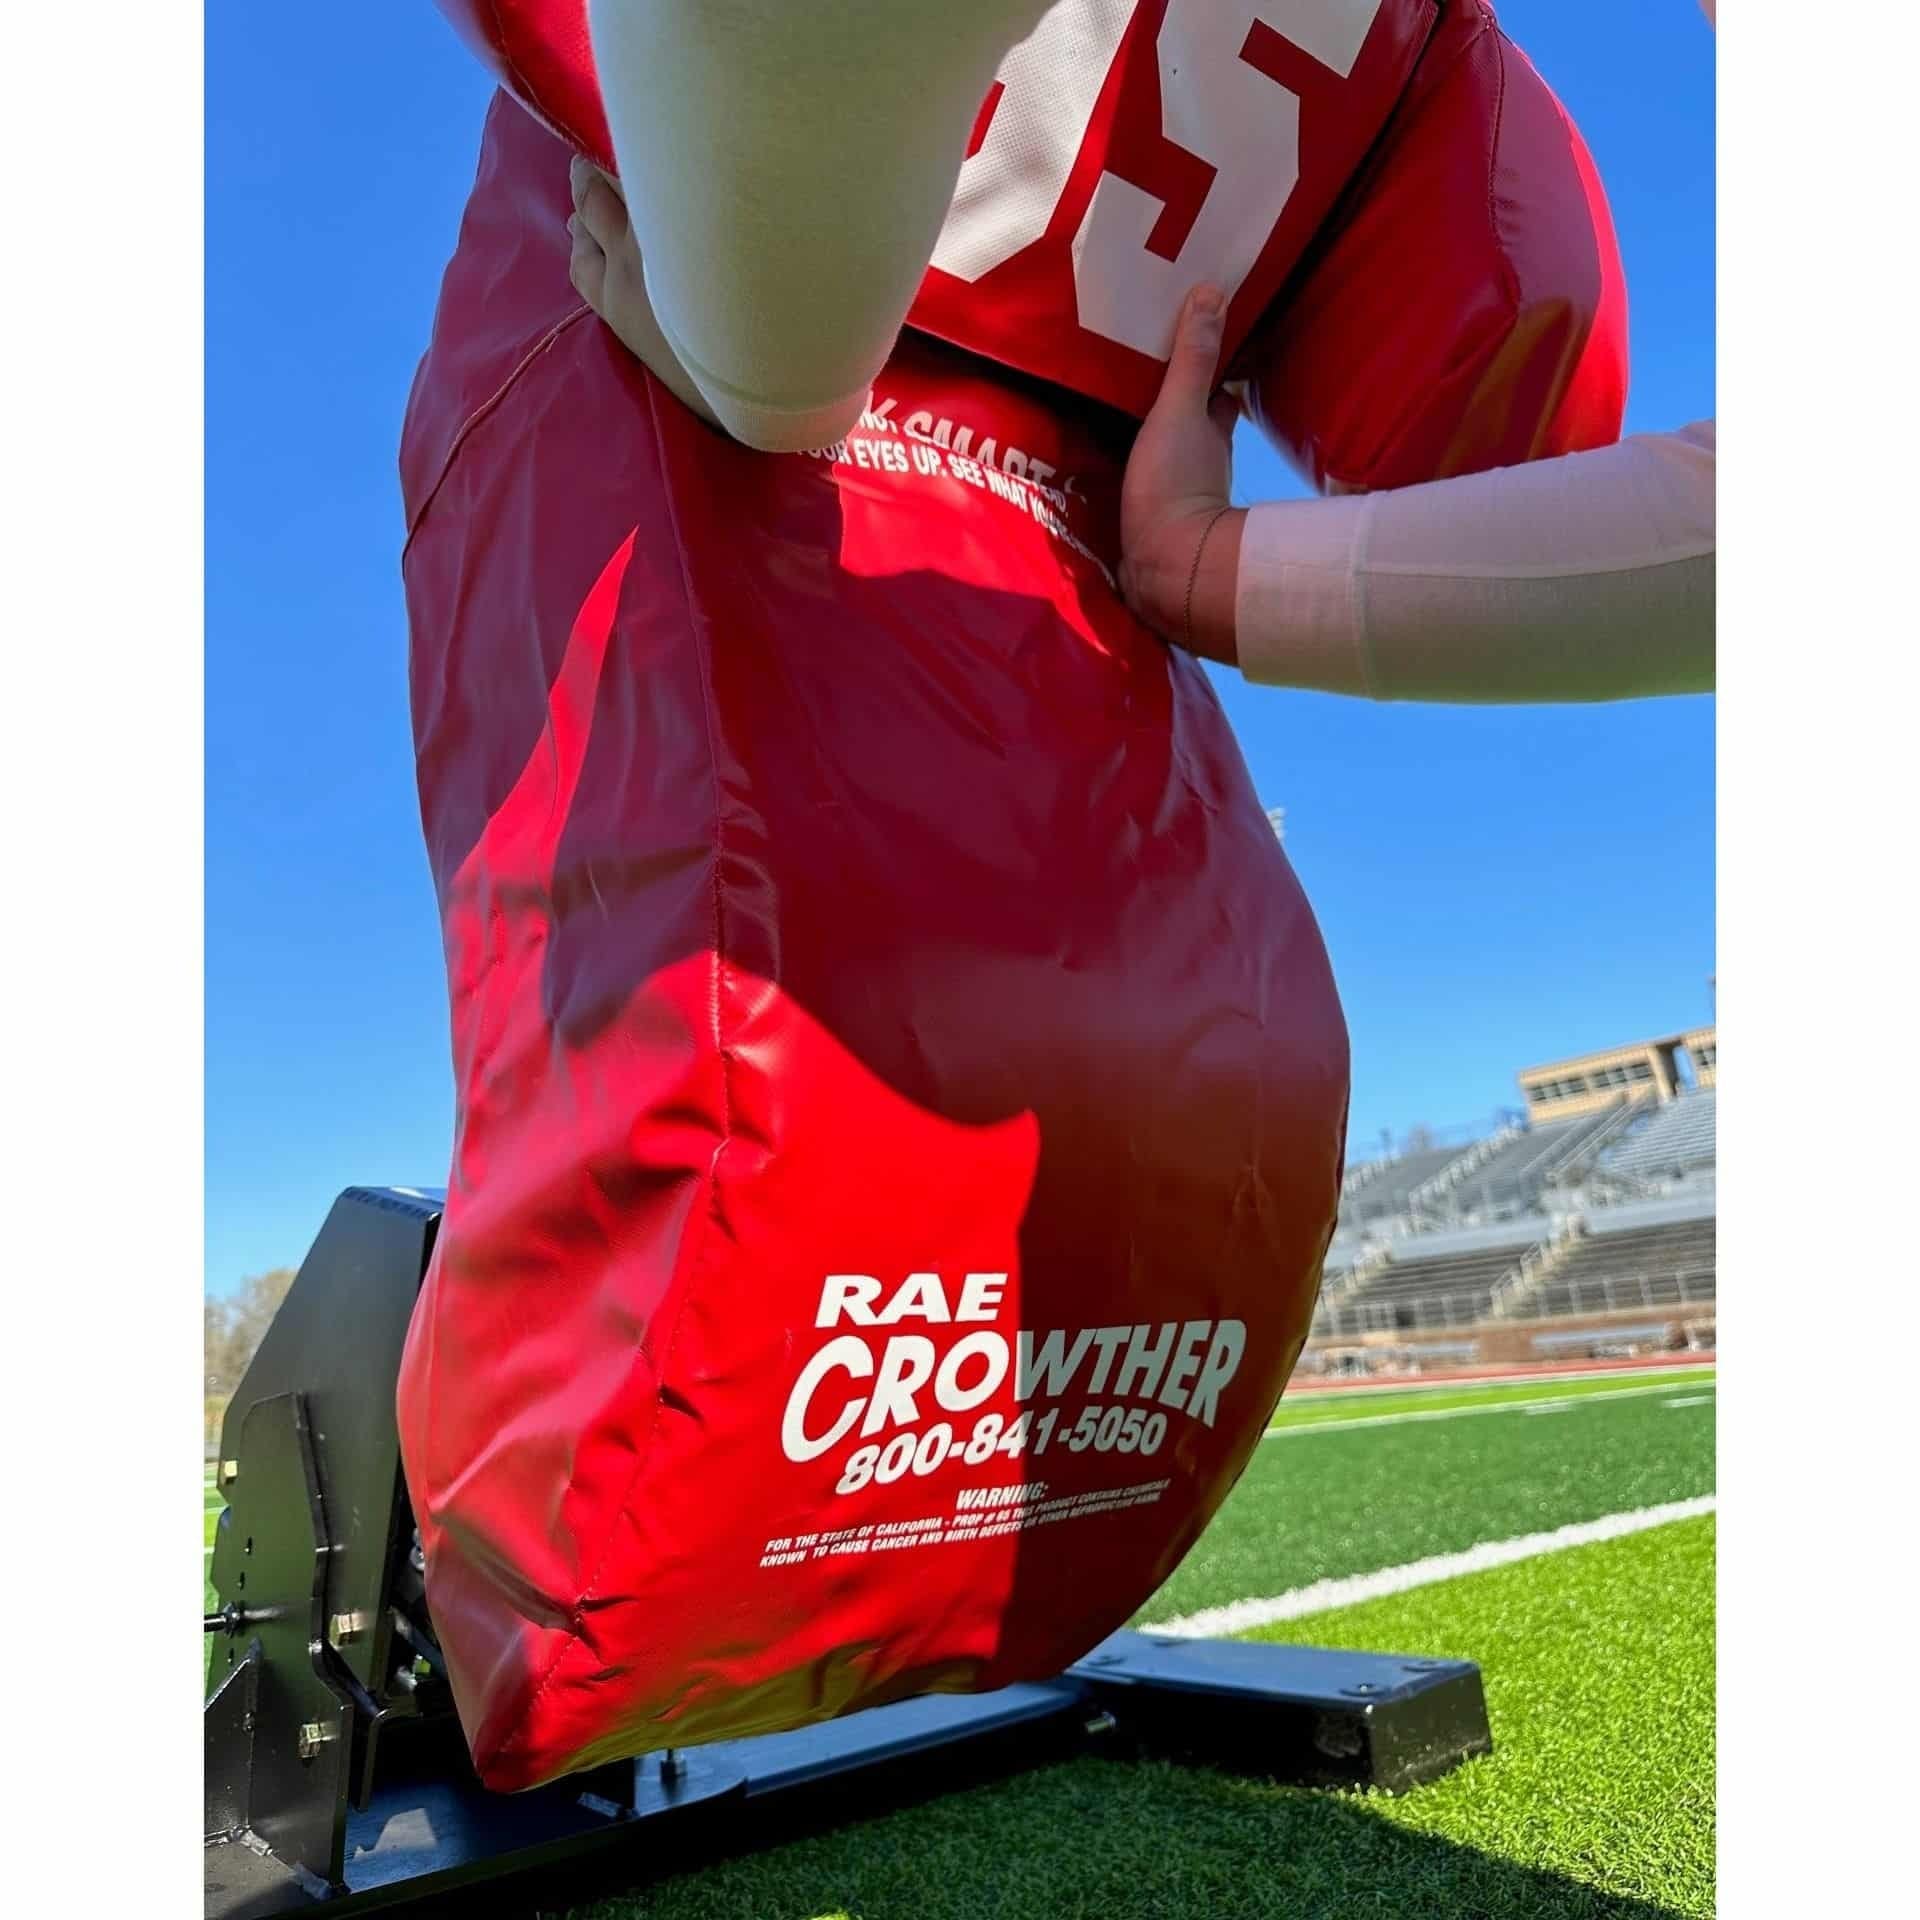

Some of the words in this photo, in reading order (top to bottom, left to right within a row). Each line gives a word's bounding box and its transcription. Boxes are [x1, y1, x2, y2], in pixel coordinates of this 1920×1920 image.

[852, 438, 909, 473] EYES
[911, 441, 948, 477] UP.
[947, 453, 985, 488] SEE
[982, 464, 1029, 513] WHAT
[814, 1272, 1009, 1329] RAE
[780, 1319, 1248, 1463] CROWTHER
[834, 1405, 1169, 1495] 800-841-5050
[956, 1481, 1049, 1510] WARNING:
[760, 1550, 807, 1568] KNOWN
[812, 1545, 828, 1559] TO
[829, 1539, 870, 1554] CAUSE
[871, 1534, 919, 1551] CANCER
[918, 1530, 943, 1545] AND
[943, 1527, 979, 1543] BIRTH
[978, 1520, 1024, 1538] DEFECTS
[765, 1537, 792, 1552] FOR
[794, 1533, 817, 1548] THE
[820, 1528, 857, 1543] STATE
[857, 1525, 875, 1538] OF
[876, 1516, 943, 1536] CALIFORNIA
[952, 1513, 984, 1528] PROP
